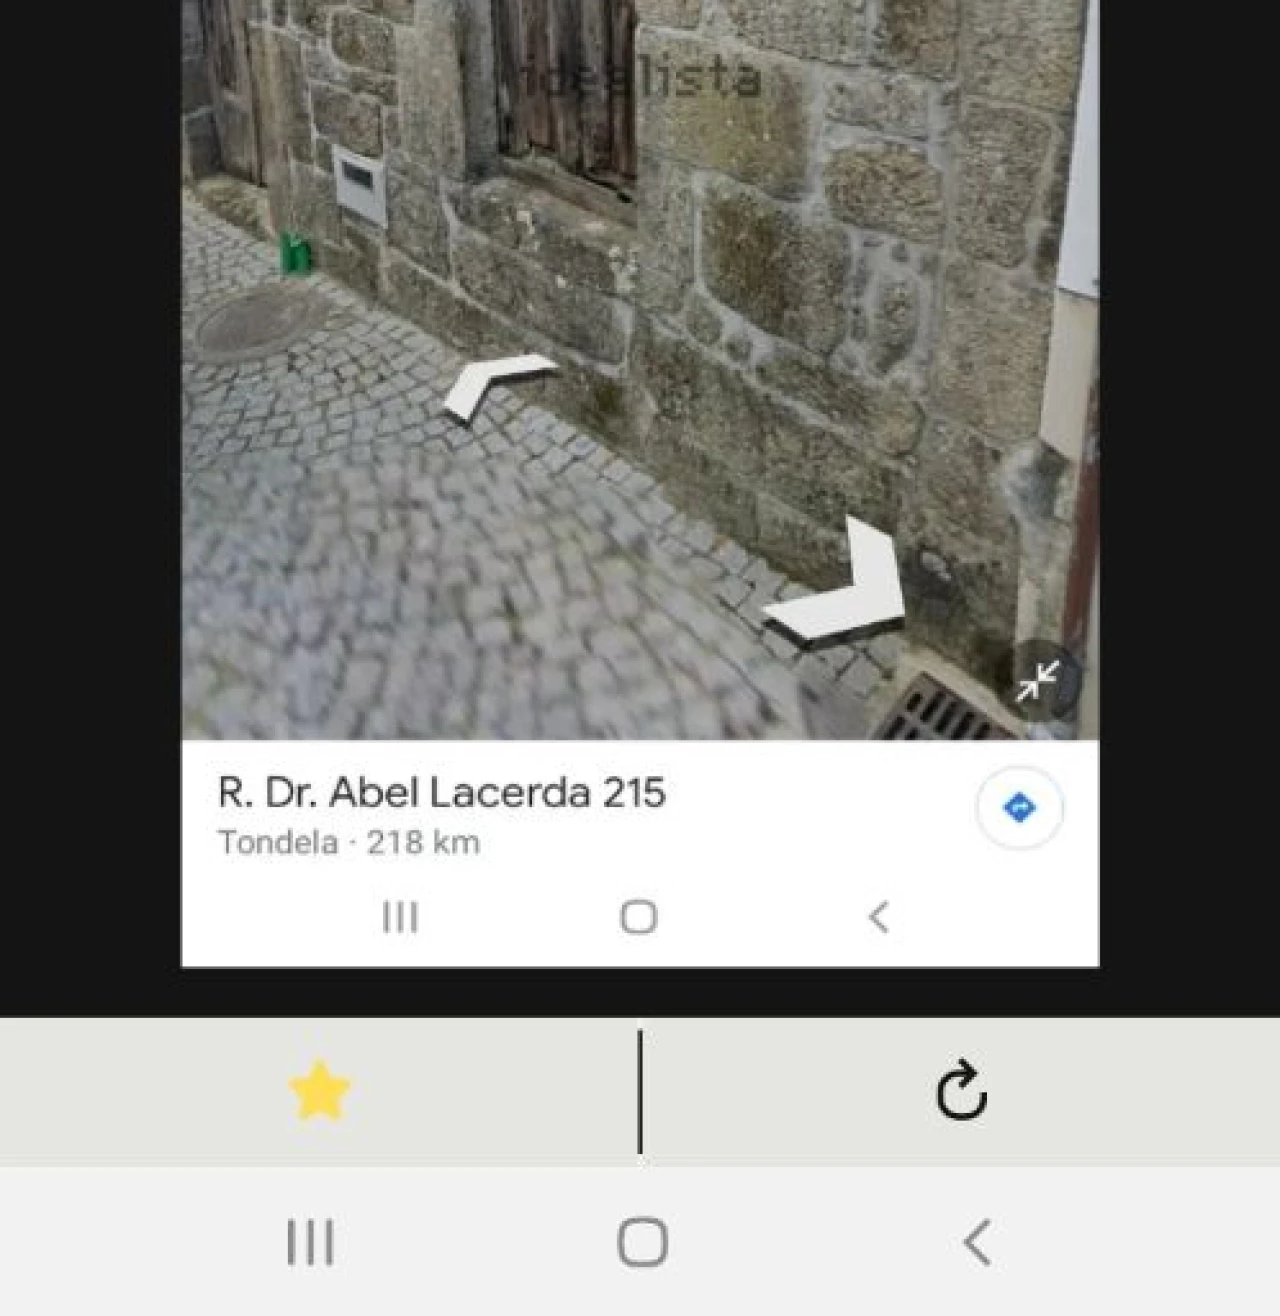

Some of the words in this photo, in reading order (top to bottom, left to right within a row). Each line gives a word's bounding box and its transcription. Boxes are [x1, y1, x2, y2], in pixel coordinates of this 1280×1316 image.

[219, 776, 253, 808] R.
[266, 776, 317, 808] Dr.
[328, 775, 419, 808] Abel
[431, 775, 592, 808] Lacerda
[603, 776, 667, 808] 215
[216, 828, 339, 856] Tondela
[367, 829, 425, 856] 218
[433, 828, 481, 856] km
